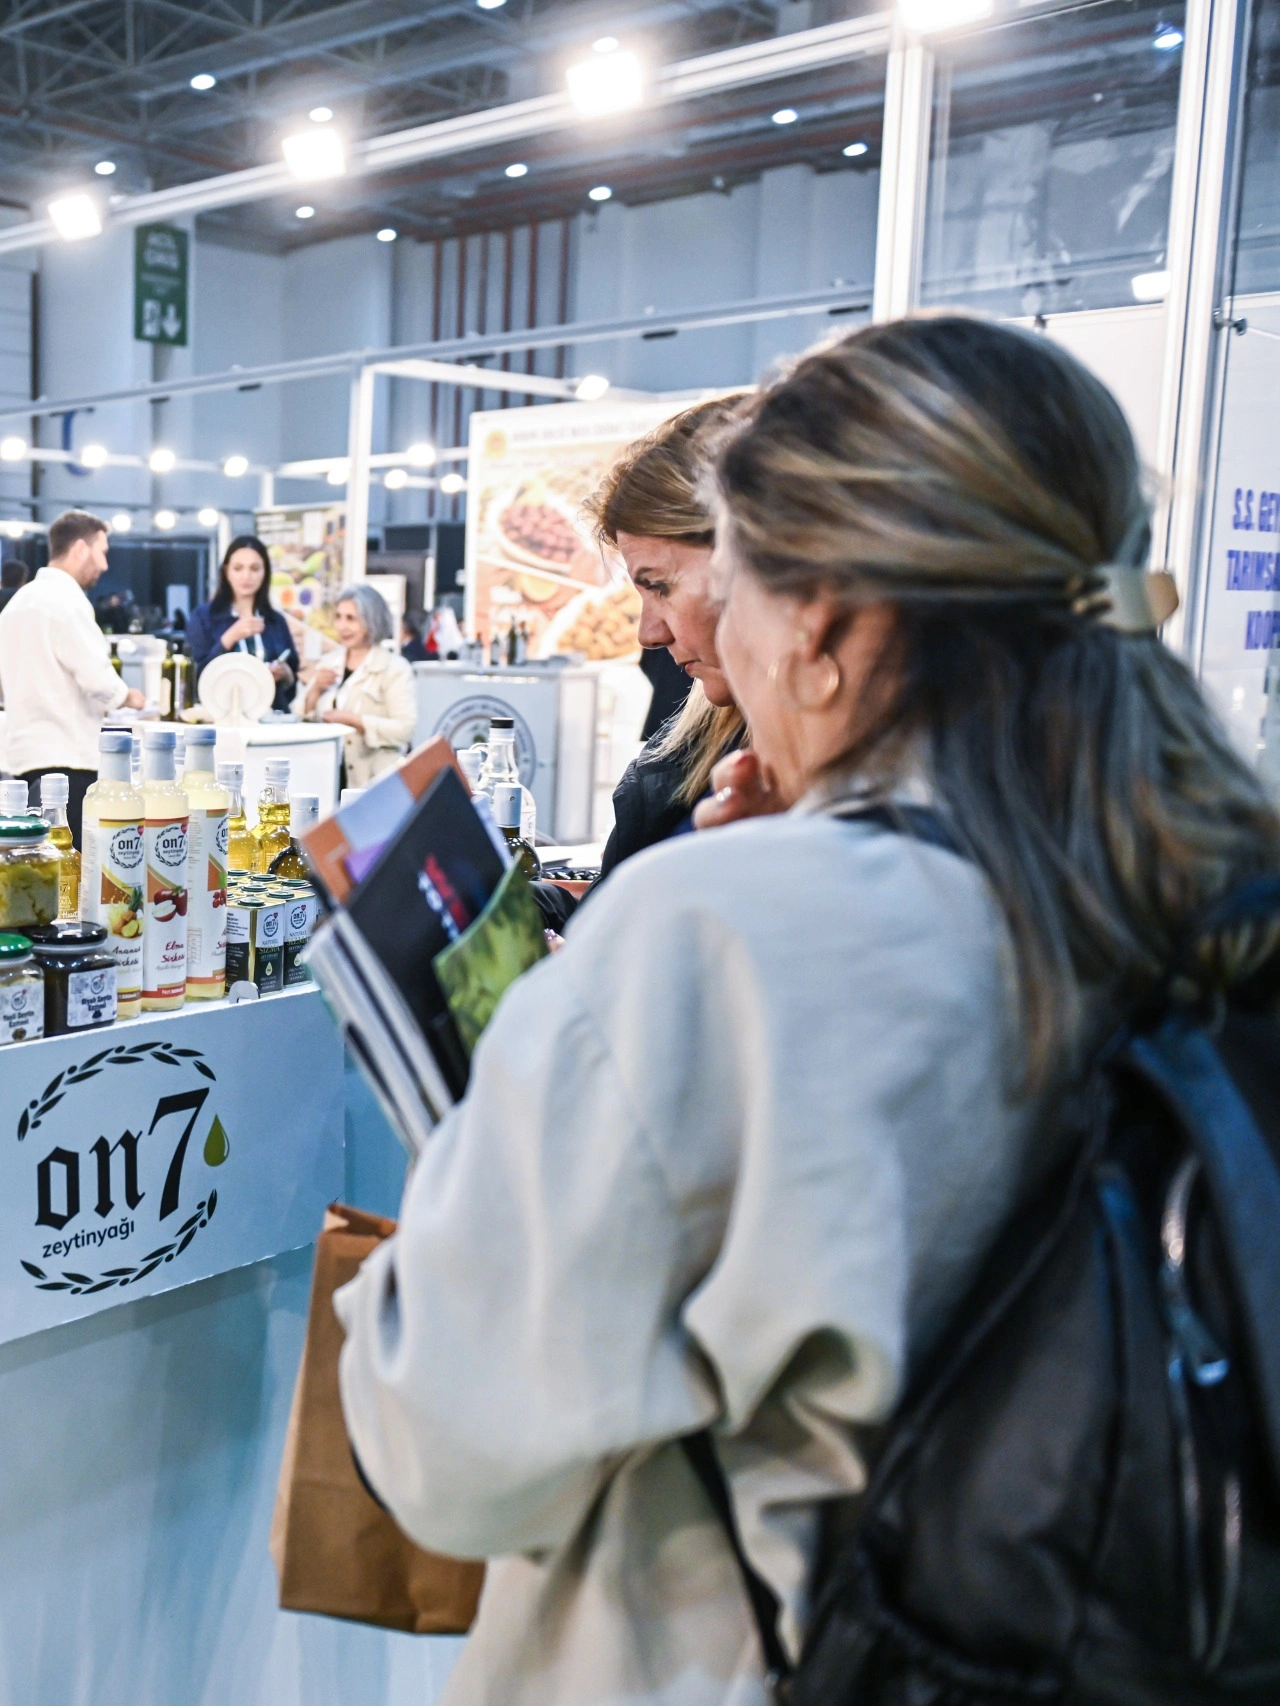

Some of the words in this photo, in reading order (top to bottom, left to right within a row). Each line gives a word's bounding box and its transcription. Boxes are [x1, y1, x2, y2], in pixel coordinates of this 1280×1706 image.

[118, 836, 140, 850] on7
[163, 834, 184, 849] on7
[35, 1086, 210, 1231] on7
[42, 1216, 135, 1259] zeytinyağı
